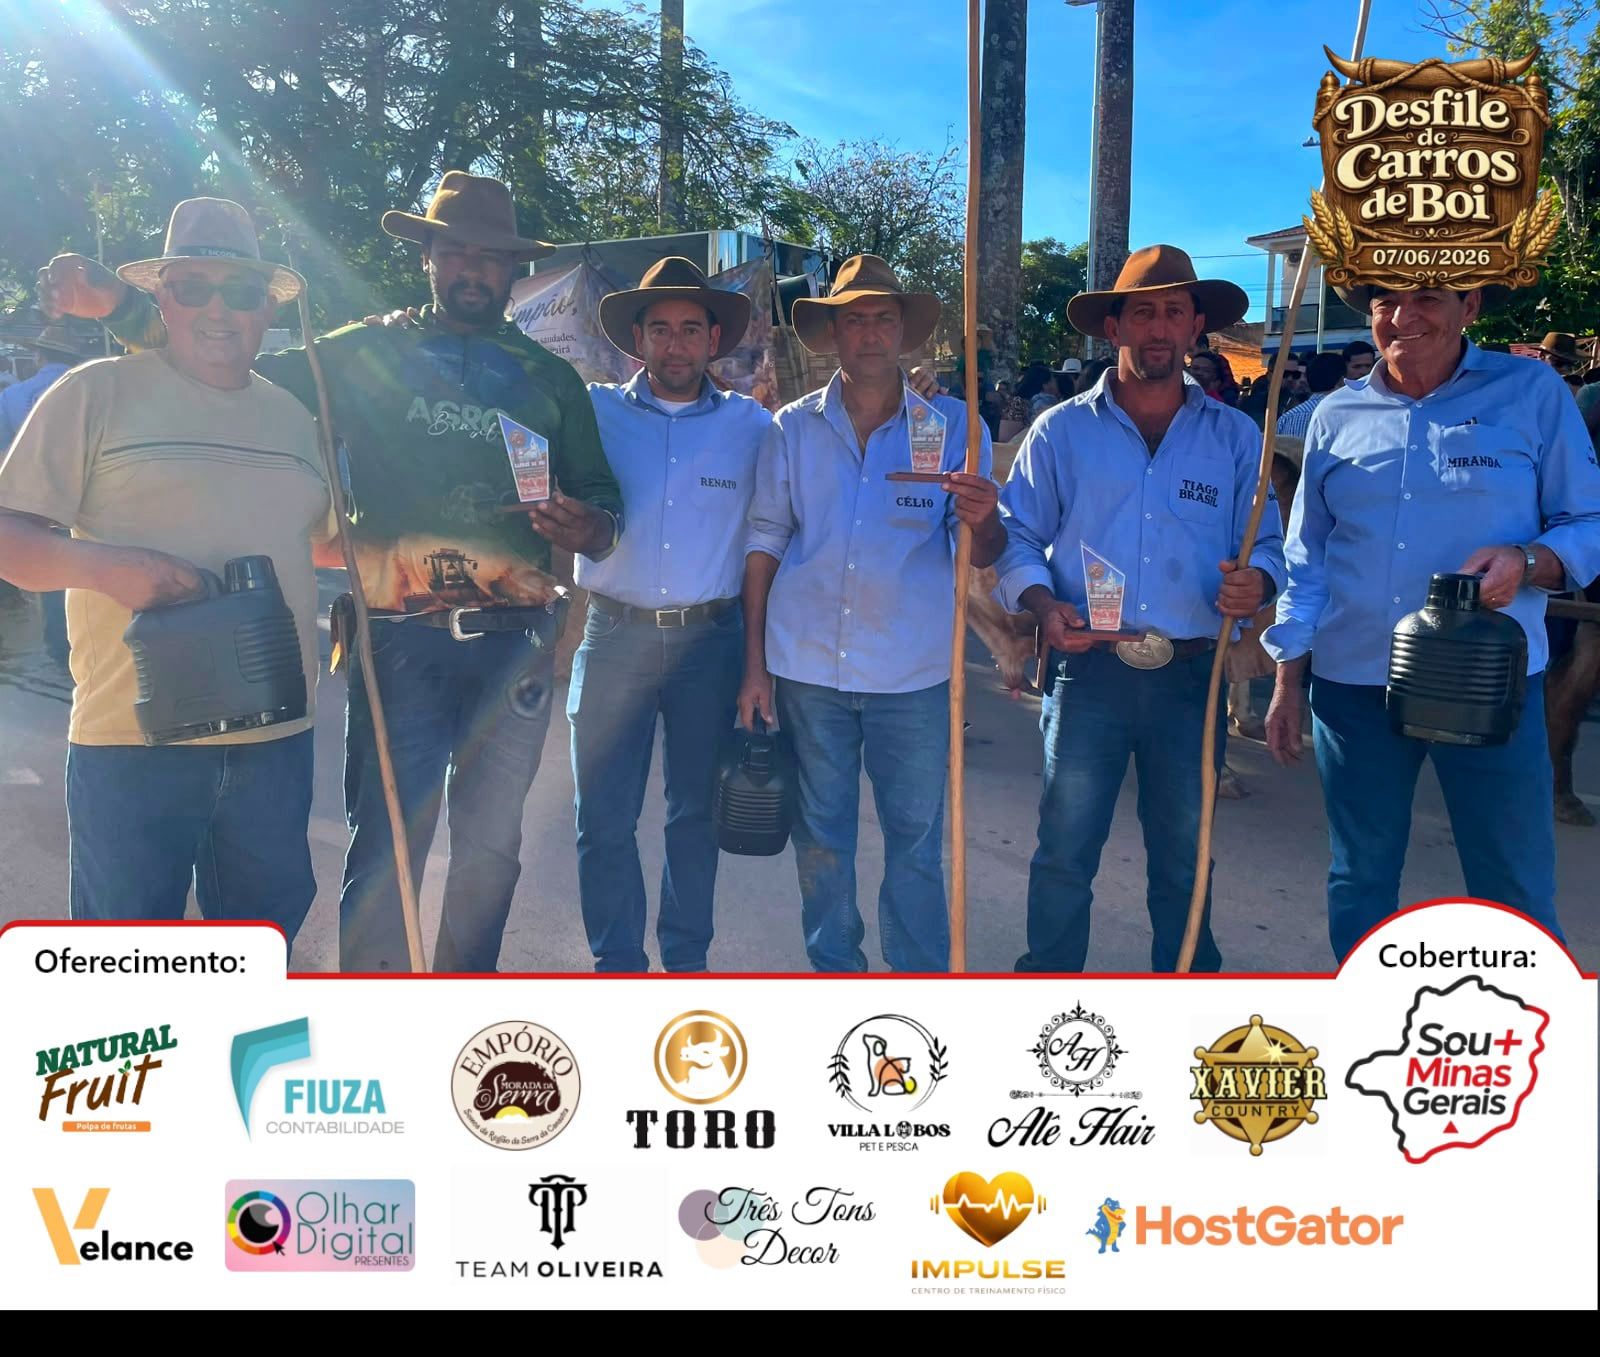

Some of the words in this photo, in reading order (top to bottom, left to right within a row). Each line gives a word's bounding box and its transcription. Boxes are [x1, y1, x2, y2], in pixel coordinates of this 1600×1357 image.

[1448, 456, 1503, 468] MIRANDA
[700, 476, 737, 490] RENATO
[1182, 479, 1219, 496] TIAGO
[896, 496, 934, 508] CÉLIO
[1179, 489, 1218, 507] BRASIL
